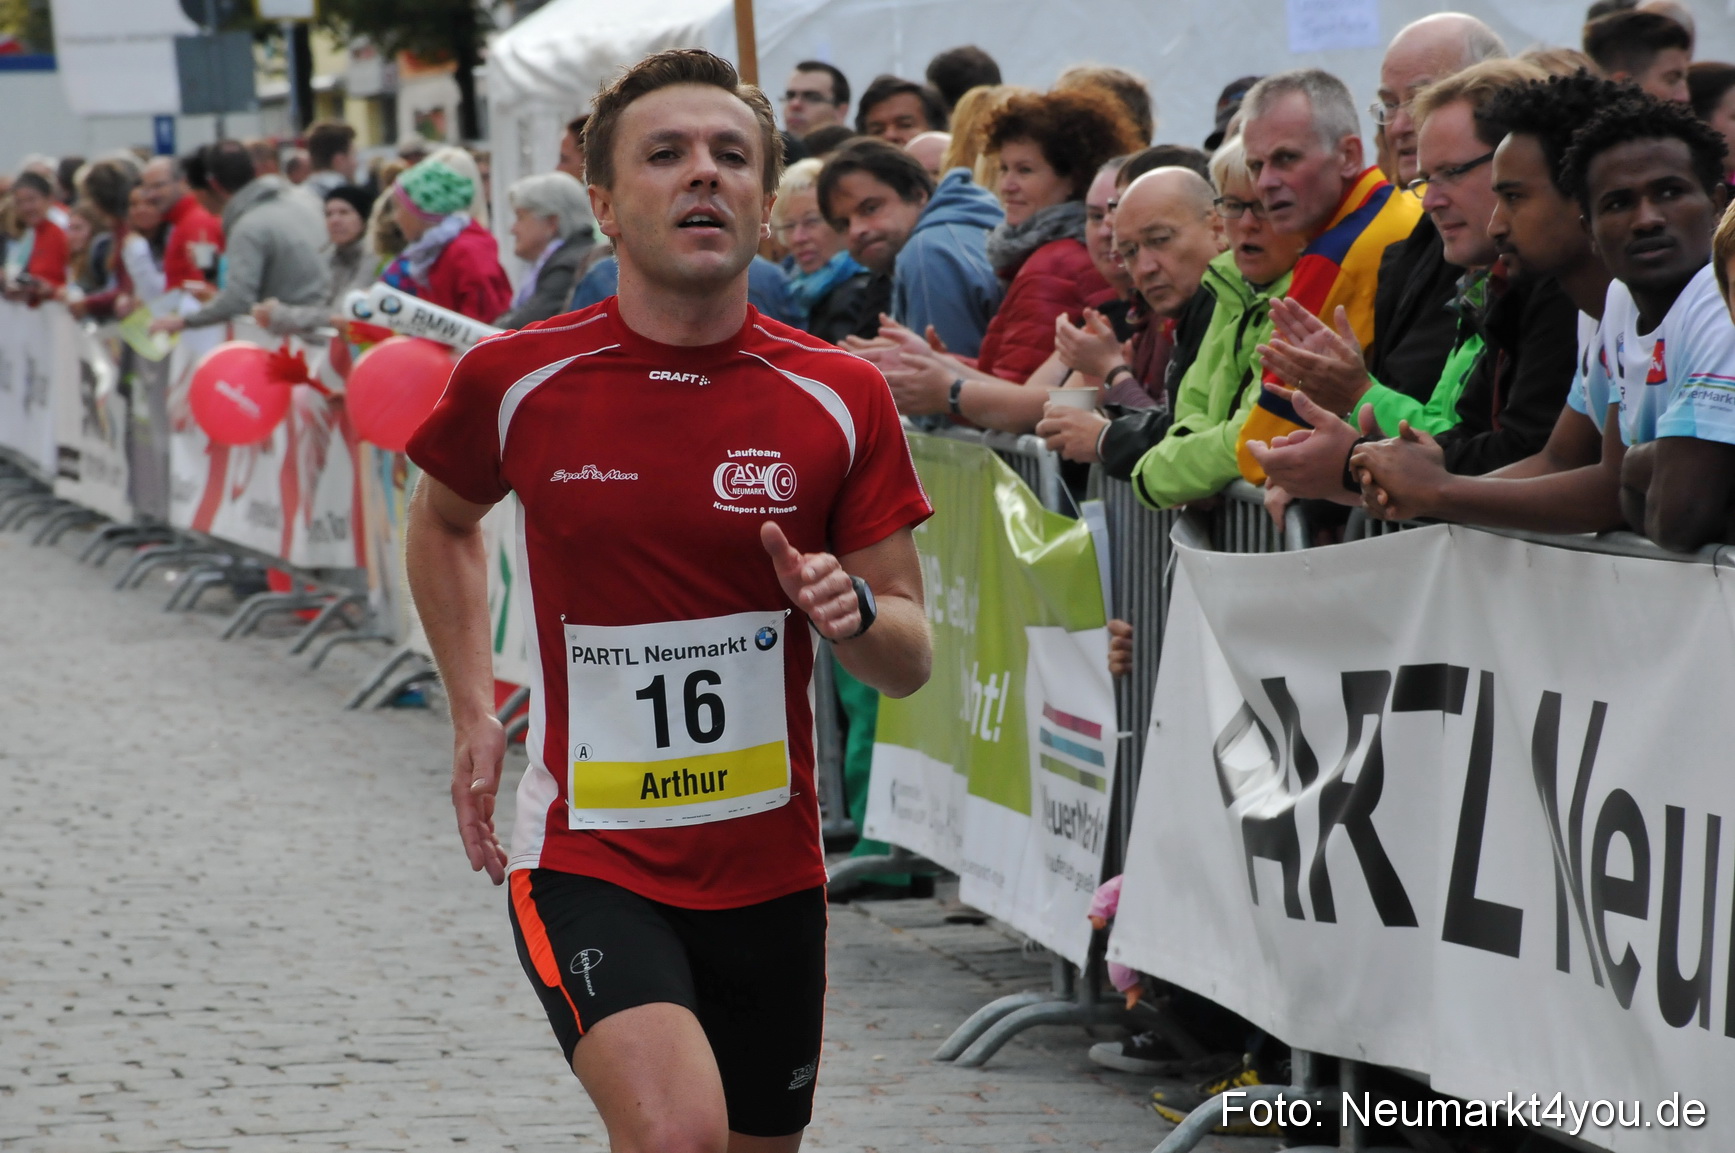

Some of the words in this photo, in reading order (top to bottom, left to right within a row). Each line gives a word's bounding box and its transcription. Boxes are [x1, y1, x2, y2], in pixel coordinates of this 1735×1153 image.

[649, 371, 699, 383] CRAFT
[727, 448, 781, 459] Laufteam
[550, 469, 590, 483] Sport
[600, 469, 639, 483] More
[733, 463, 767, 486] ASV
[732, 487, 766, 495] NEUMARKT
[713, 500, 757, 514] Kraftsport
[759, 506, 766, 514] &
[768, 505, 798, 514] Fitness
[571, 646, 639, 665] PARTL
[644, 636, 747, 664] Neumarkt
[635, 669, 726, 749] 16
[579, 746, 588, 759] A
[640, 768, 728, 800] Arthur
[1531, 690, 1735, 1038] Neu
